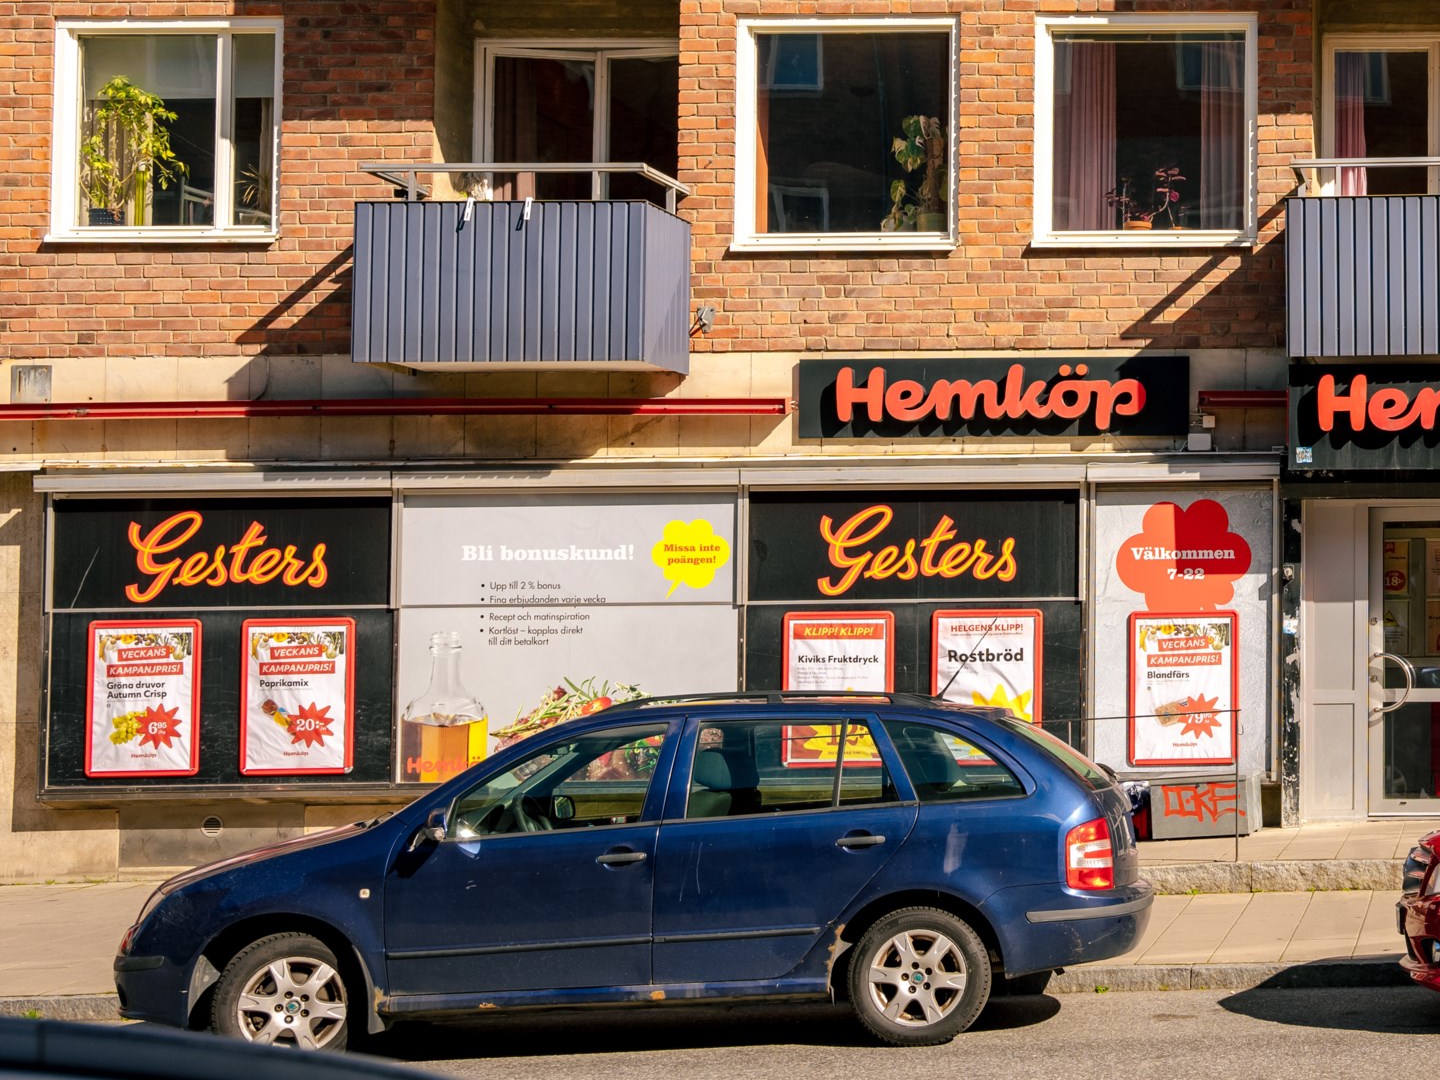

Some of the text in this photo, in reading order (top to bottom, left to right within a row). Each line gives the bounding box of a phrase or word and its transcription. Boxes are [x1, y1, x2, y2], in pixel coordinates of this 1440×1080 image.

[835, 364, 1146, 430] Hemköp
[461, 544, 634, 561] Bli bonuskund!
[663, 543, 721, 552] Missa inte
[817, 504, 1017, 597] Gesters
[125, 510, 328, 603] Gesters
[1131, 547, 1235, 560] Välkommen
[667, 555, 717, 566] poängen!
[1167, 568, 1205, 580] 7-22
[489, 581, 561, 592] Upp till 2 % bonus
[489, 595, 606, 608] Fina erbjudanden varje vecka
[489, 612, 590, 622] Recept och matinspiration
[488, 626, 519, 635] Kortlöst
[527, 626, 559, 636] kopplas
[560, 626, 583, 635] direkt
[804, 626, 874, 636] KLIPP! KLIPP!
[951, 623, 1024, 632] HELGENS KLIPP!
[488, 637, 549, 646] till ditt betalkort
[1162, 639, 1206, 650] VECKANS
[121, 648, 167, 659] VECKANS
[274, 647, 319, 657] VECKANS
[947, 647, 1024, 663] Rostbröd
[798, 655, 879, 665] Kiviks Fruktdryck
[1150, 655, 1219, 665] KAMPANJPRIS!
[109, 664, 180, 675] KAMPANJPRIS!
[262, 663, 332, 673] KAMPANJPRIS!
[1147, 670, 1190, 680] Blandfärs
[106, 681, 166, 690] Gröna druvor
[259, 678, 309, 688] Paprikamix
[106, 690, 168, 700] Autumn Crisp
[131, 752, 157, 760] Hemköp
